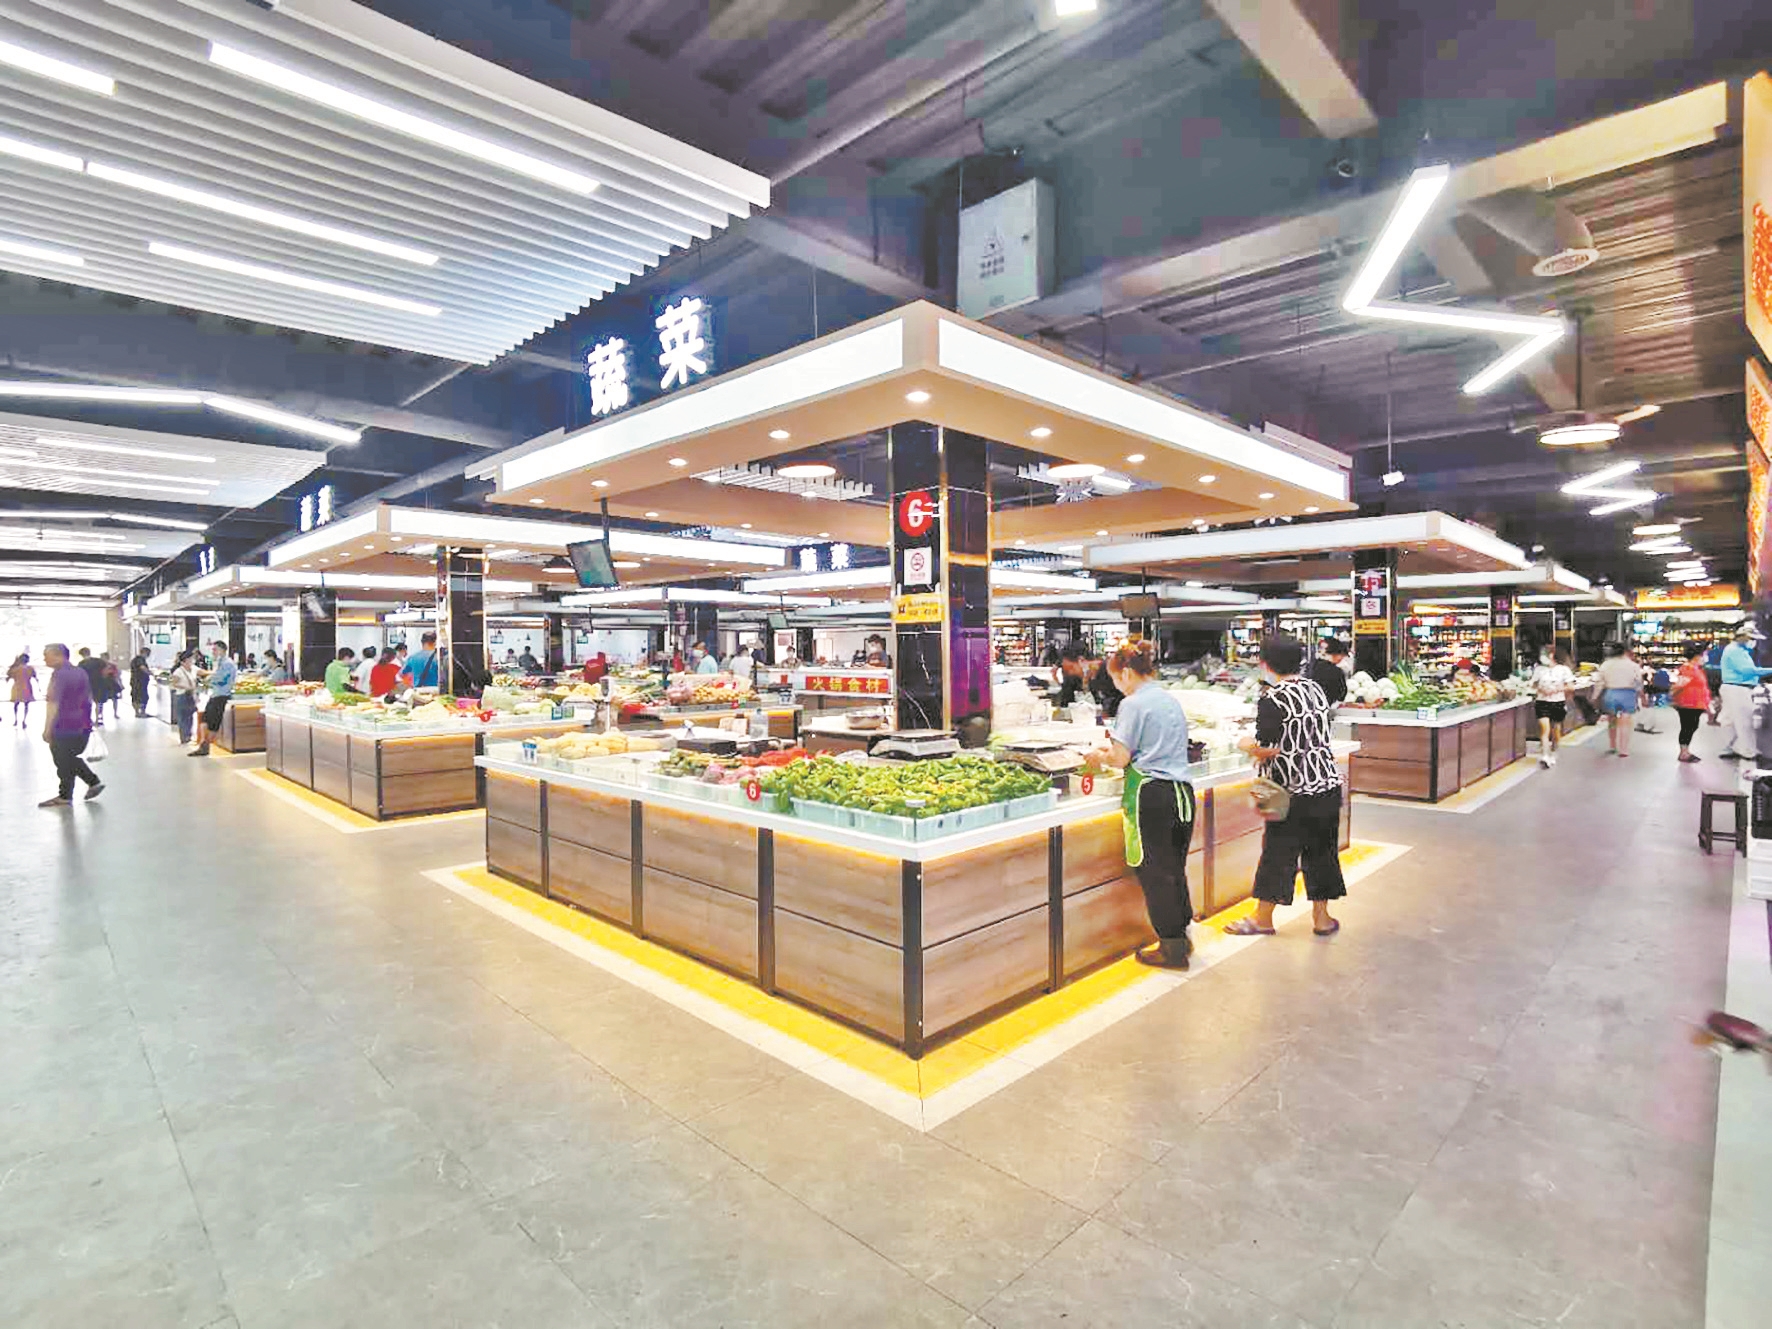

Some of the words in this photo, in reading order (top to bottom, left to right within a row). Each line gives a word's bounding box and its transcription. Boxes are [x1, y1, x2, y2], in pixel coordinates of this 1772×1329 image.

[588, 296, 707, 416] 蔬菜
[908, 498, 925, 528] 6
[749, 782, 757, 799] 6
[1083, 777, 1091, 793] 5
